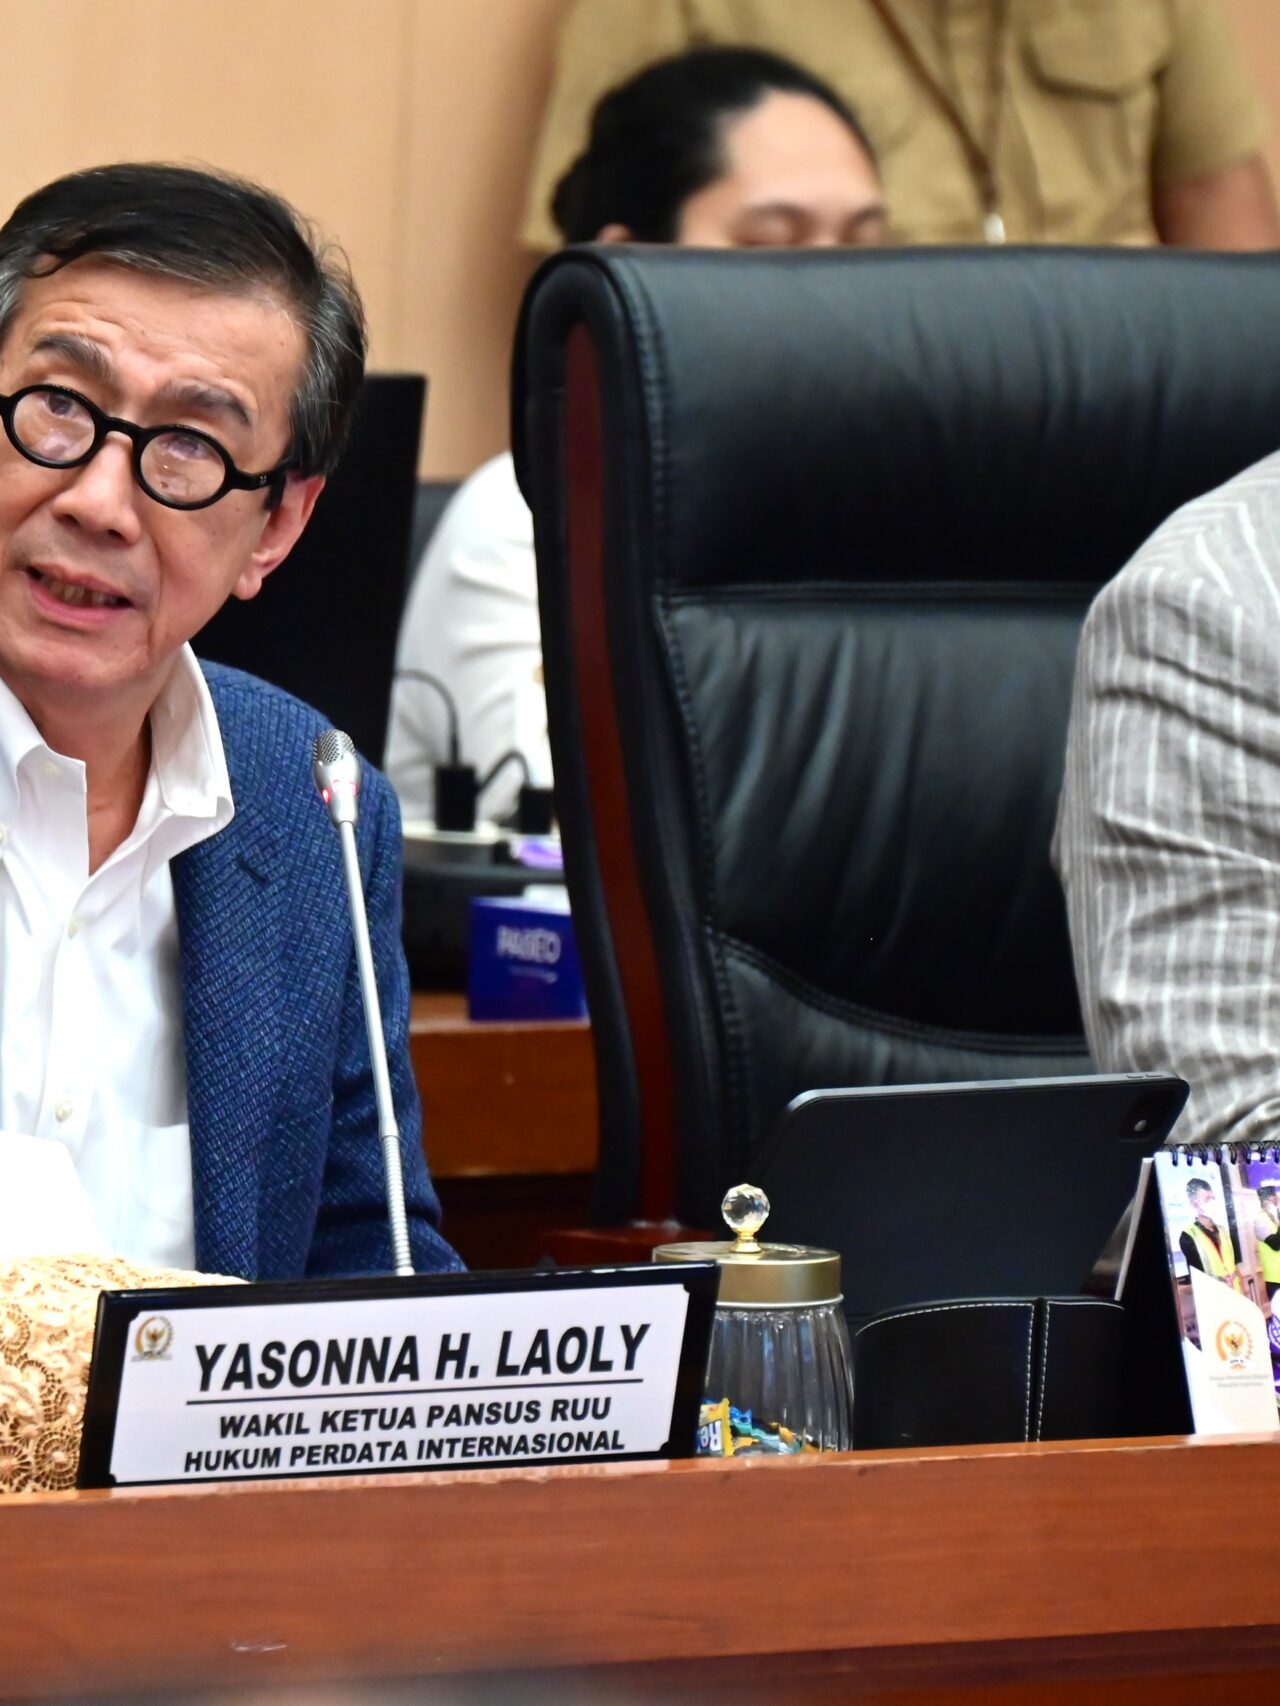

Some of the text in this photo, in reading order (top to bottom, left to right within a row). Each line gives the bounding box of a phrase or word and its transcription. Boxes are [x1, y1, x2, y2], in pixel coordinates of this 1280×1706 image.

[195, 1323, 651, 1392] YASONNA H. LAOLY
[219, 1397, 612, 1439] WAKIL KETUA PANSUS RUU
[184, 1430, 625, 1473] HUKUM PERDATA INTERNASIONAL
